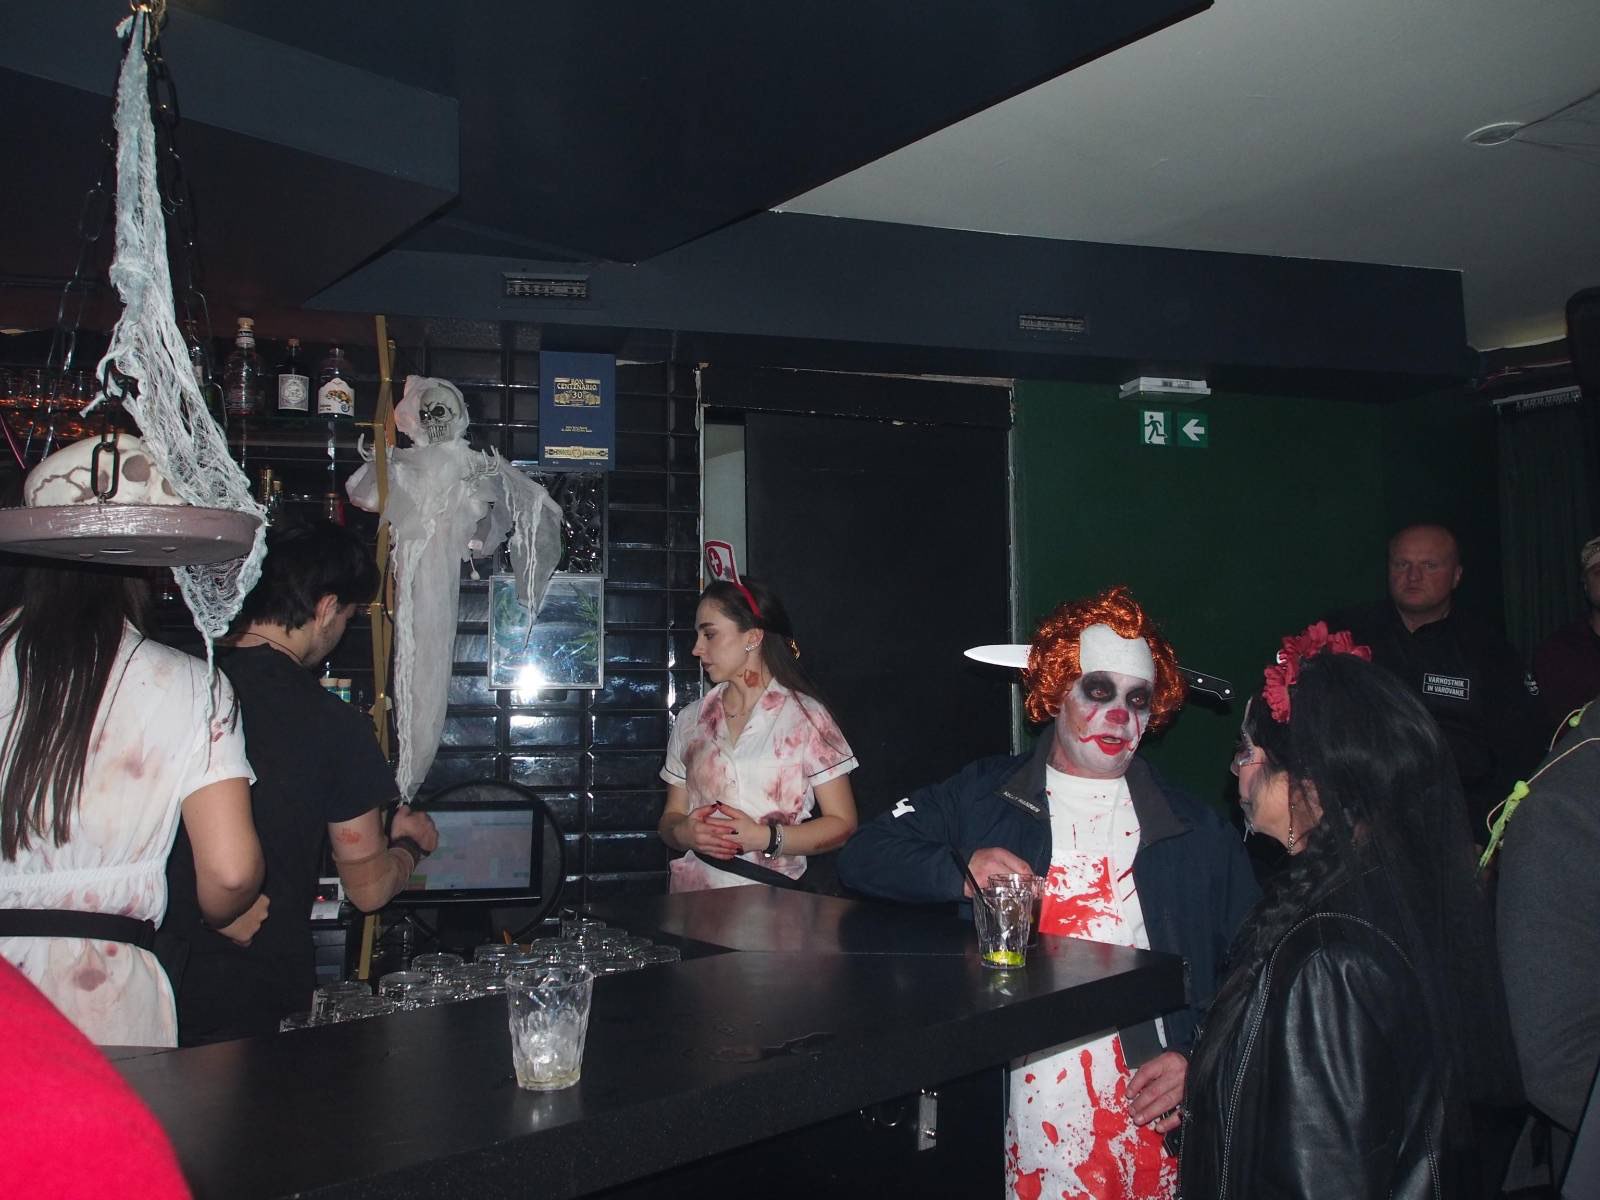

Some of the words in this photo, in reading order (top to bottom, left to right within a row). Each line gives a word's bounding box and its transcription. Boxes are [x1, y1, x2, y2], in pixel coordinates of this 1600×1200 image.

[556, 383, 597, 391] CENTENARIO
[572, 391, 583, 399] 30
[1428, 676, 1465, 687] VARNOSTNIK
[1434, 686, 1465, 697] VAROVANJE
